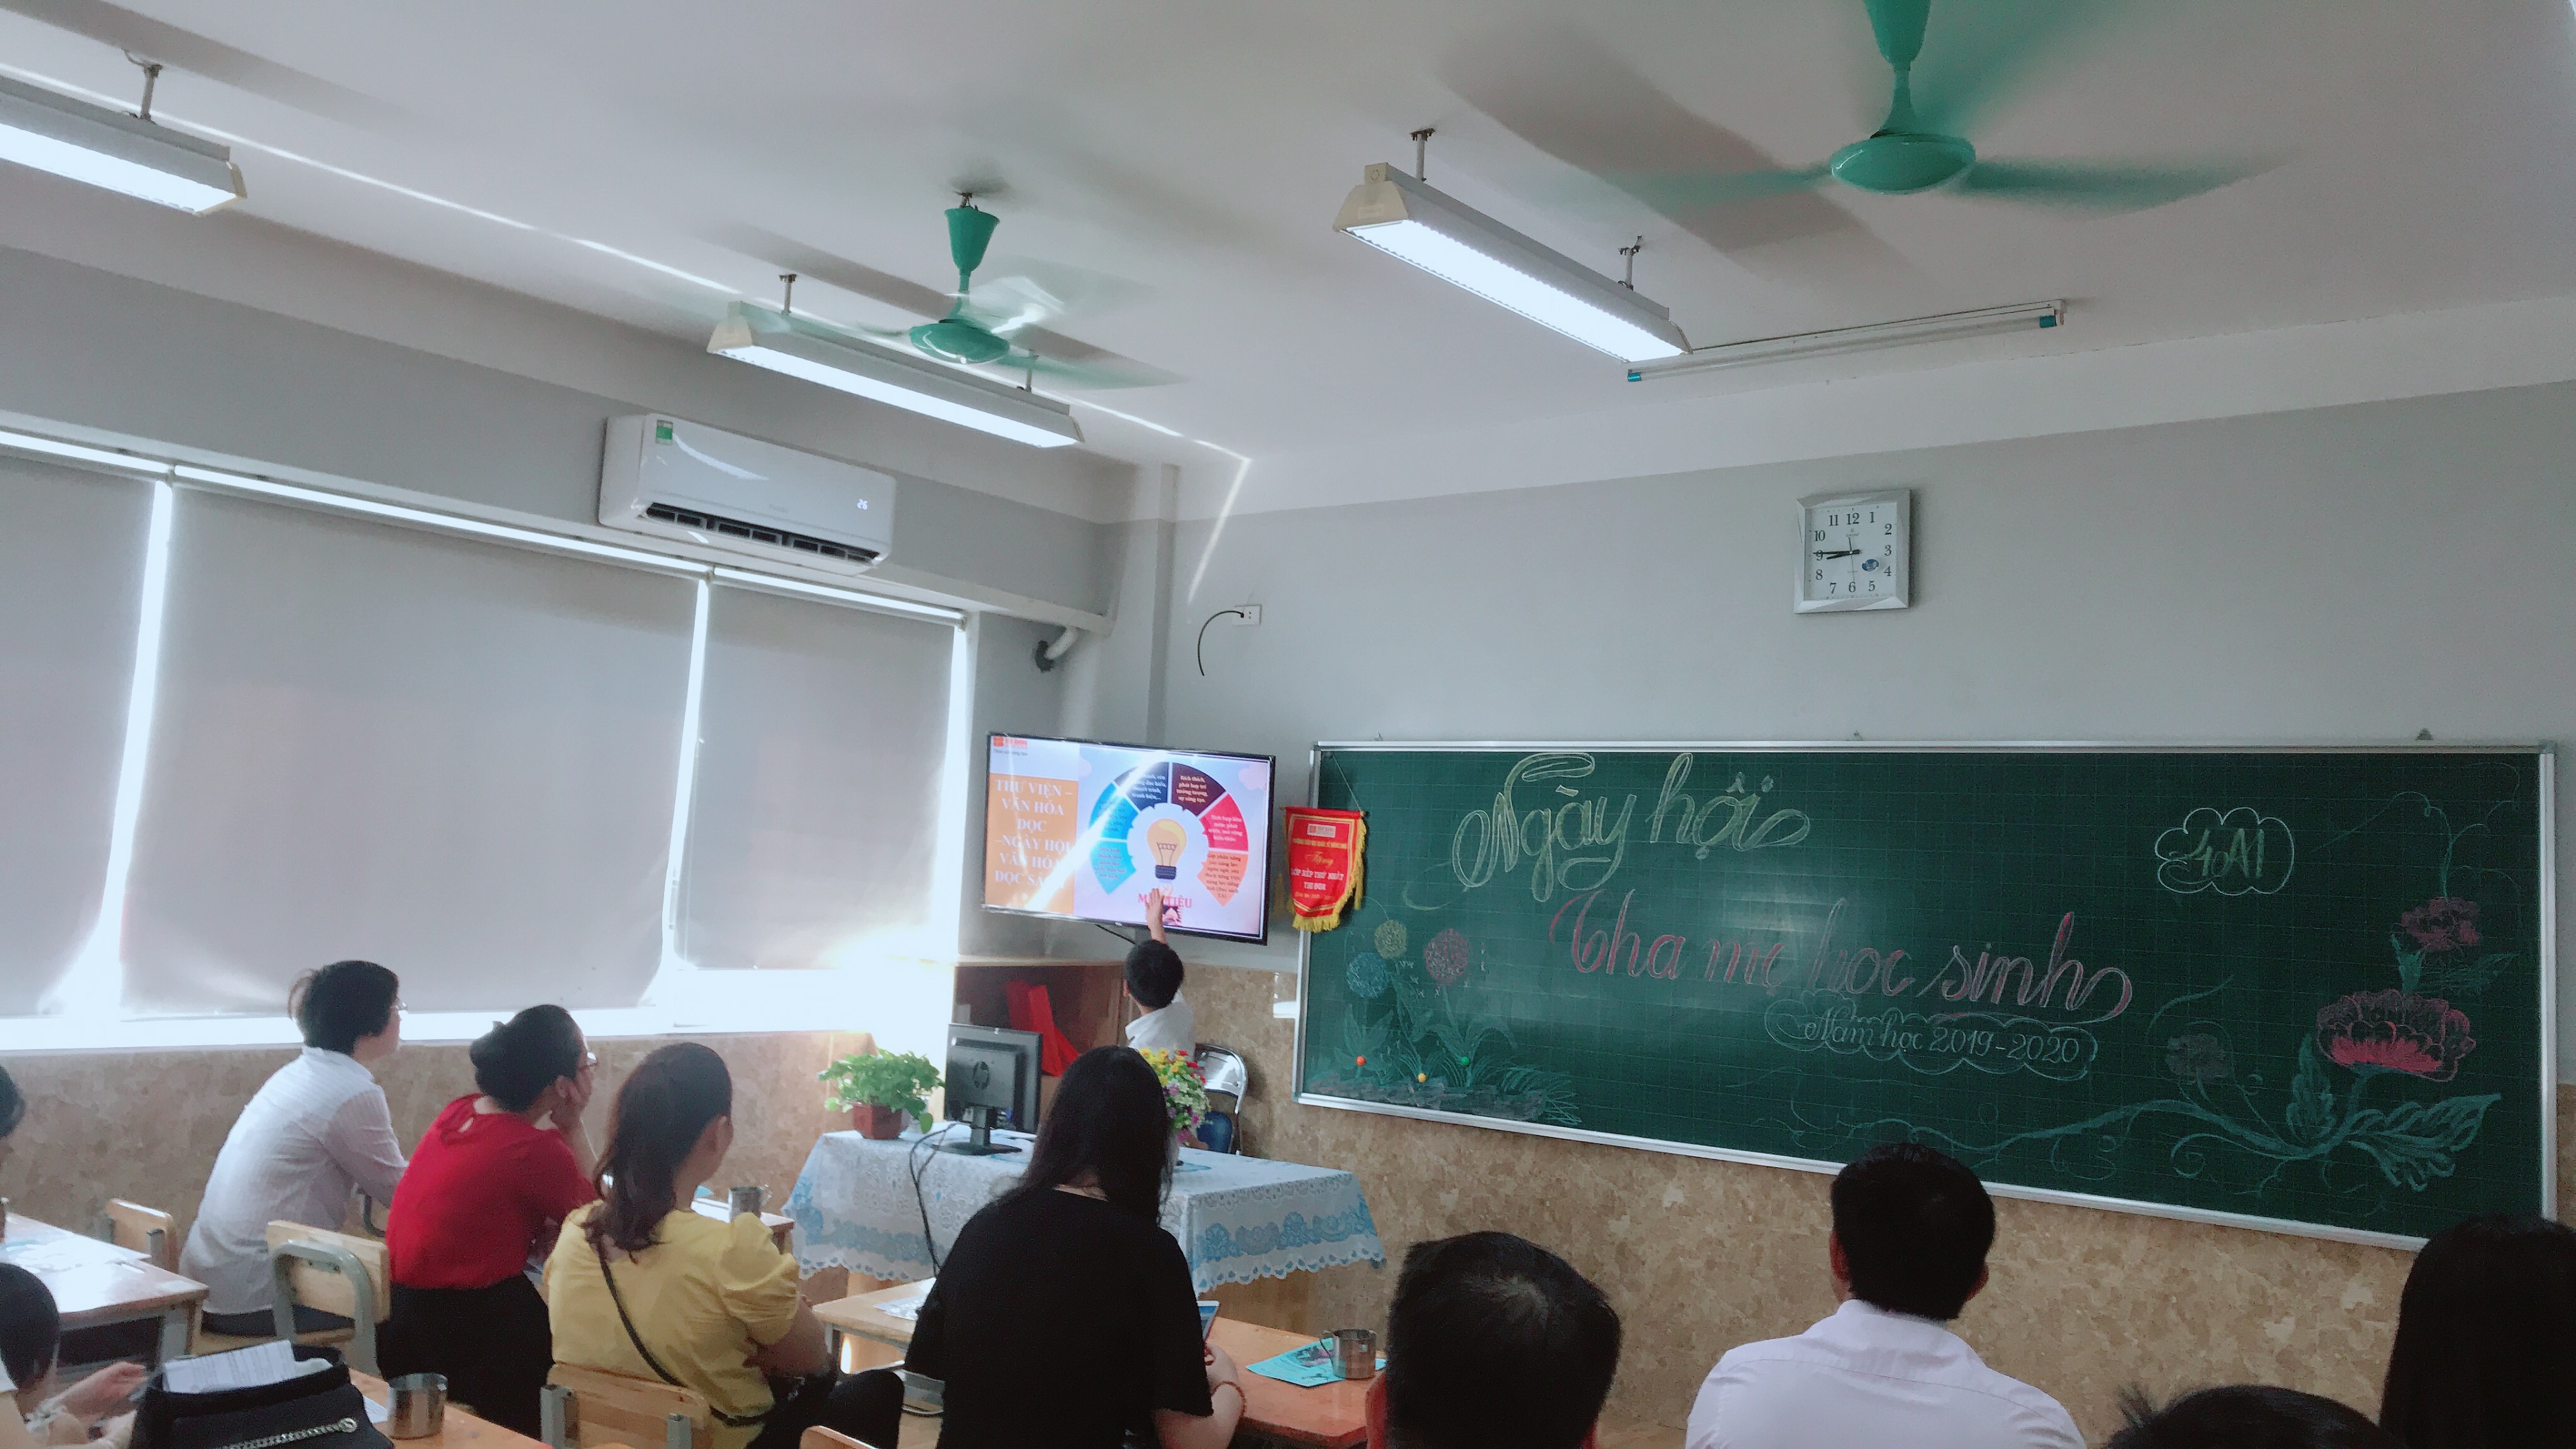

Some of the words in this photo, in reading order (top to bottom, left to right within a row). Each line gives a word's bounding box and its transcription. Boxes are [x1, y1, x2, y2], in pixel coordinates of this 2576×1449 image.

[1829, 515, 1839, 526] 11
[1847, 513, 1860, 525] 12
[1870, 512, 1875, 523] 1
[1815, 530, 1825, 541] 10
[1884, 523, 1892, 535] 2
[1884, 545, 1892, 556] 3
[1815, 570, 1823, 580] 8
[1884, 566, 1892, 576] 4
[1830, 582, 1837, 594] 7
[1848, 581, 1856, 592] 6
[1868, 580, 1876, 592] 5
[1028, 782, 1061, 799] VIỆN
[1452, 752, 1637, 902] Ngày
[1646, 752, 1811, 860] hội
[1914, 910, 2133, 1022] sinh
[1880, 1013, 1923, 1053] học
